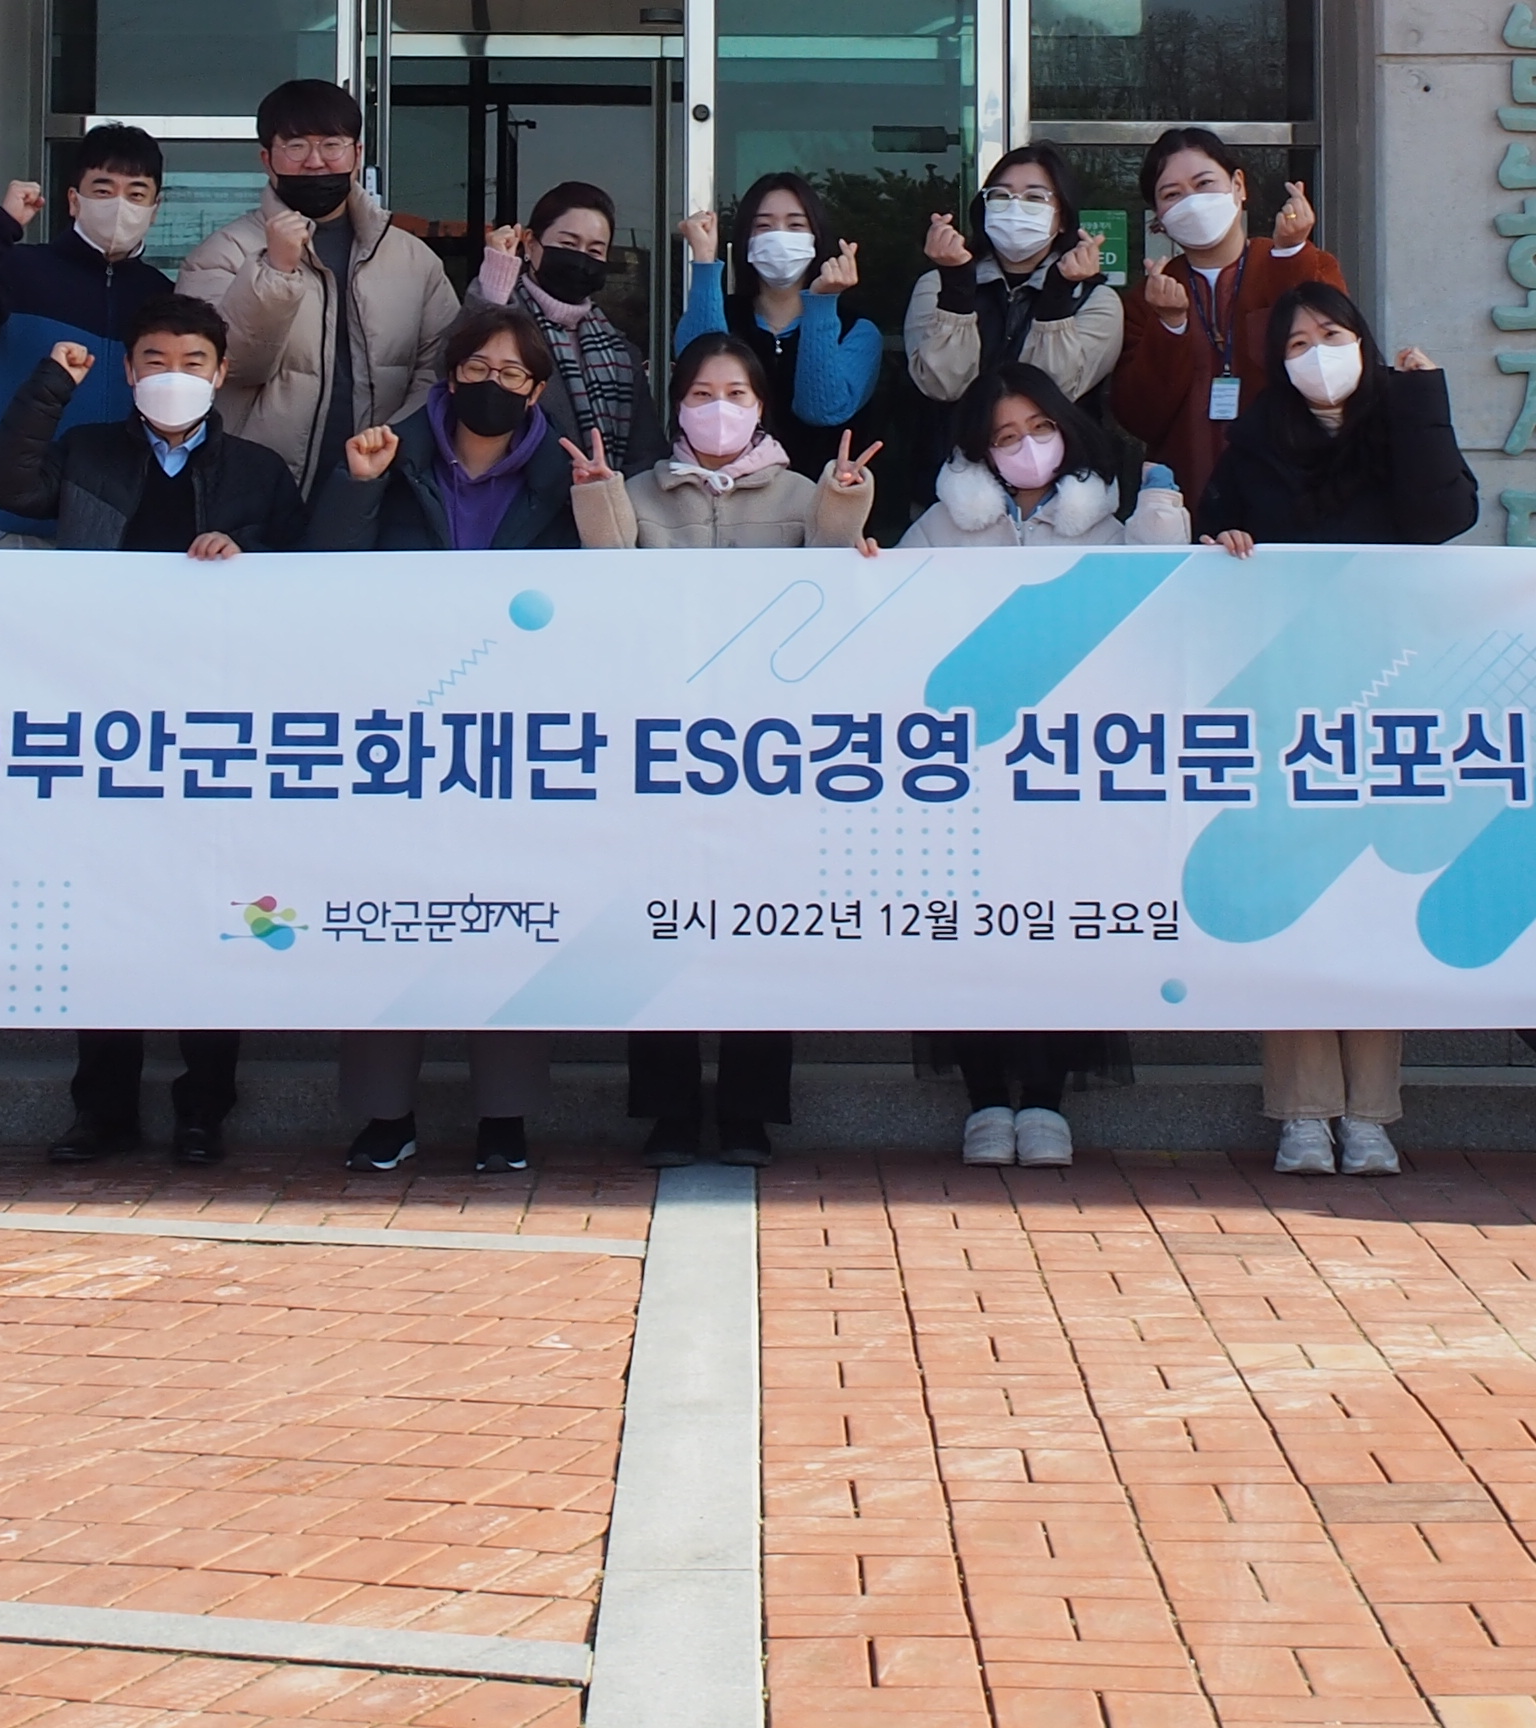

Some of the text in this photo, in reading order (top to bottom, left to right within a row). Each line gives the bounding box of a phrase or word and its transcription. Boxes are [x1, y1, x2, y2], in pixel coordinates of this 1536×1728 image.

[634, 710, 973, 804] ESG경영
[1004, 712, 1254, 803] 선언문
[1282, 711, 1528, 802] 선포식
[645, 899, 1181, 941] 일시 2022년 12월 30일 금요일
